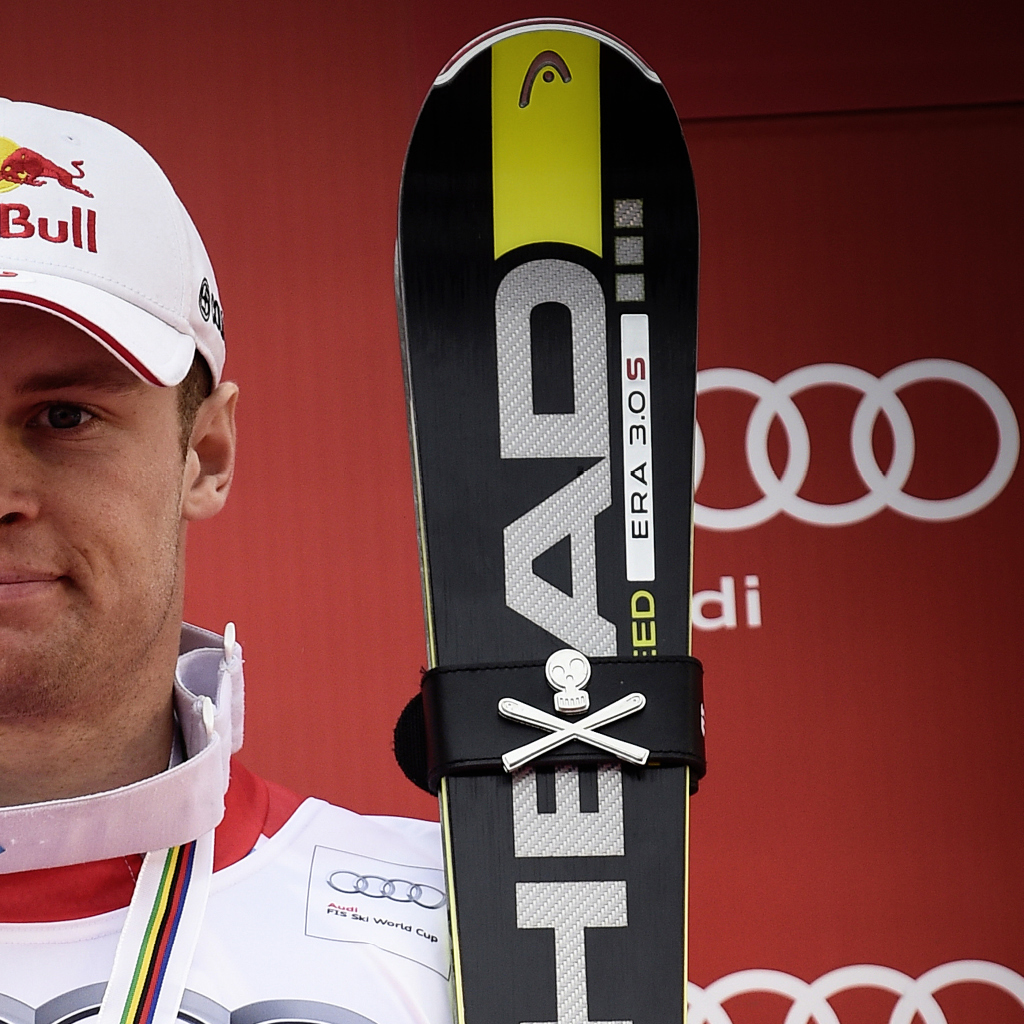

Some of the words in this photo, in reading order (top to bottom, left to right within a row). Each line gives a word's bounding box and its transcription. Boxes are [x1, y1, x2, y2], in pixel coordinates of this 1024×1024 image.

[0, 203, 98, 254] Bull
[630, 461, 649, 539] ERA
[327, 902, 358, 912] Audi
[327, 908, 347, 917] FIS
[351, 912, 369, 922] Ski
[373, 917, 412, 932] World
[416, 928, 438, 943] Cup
